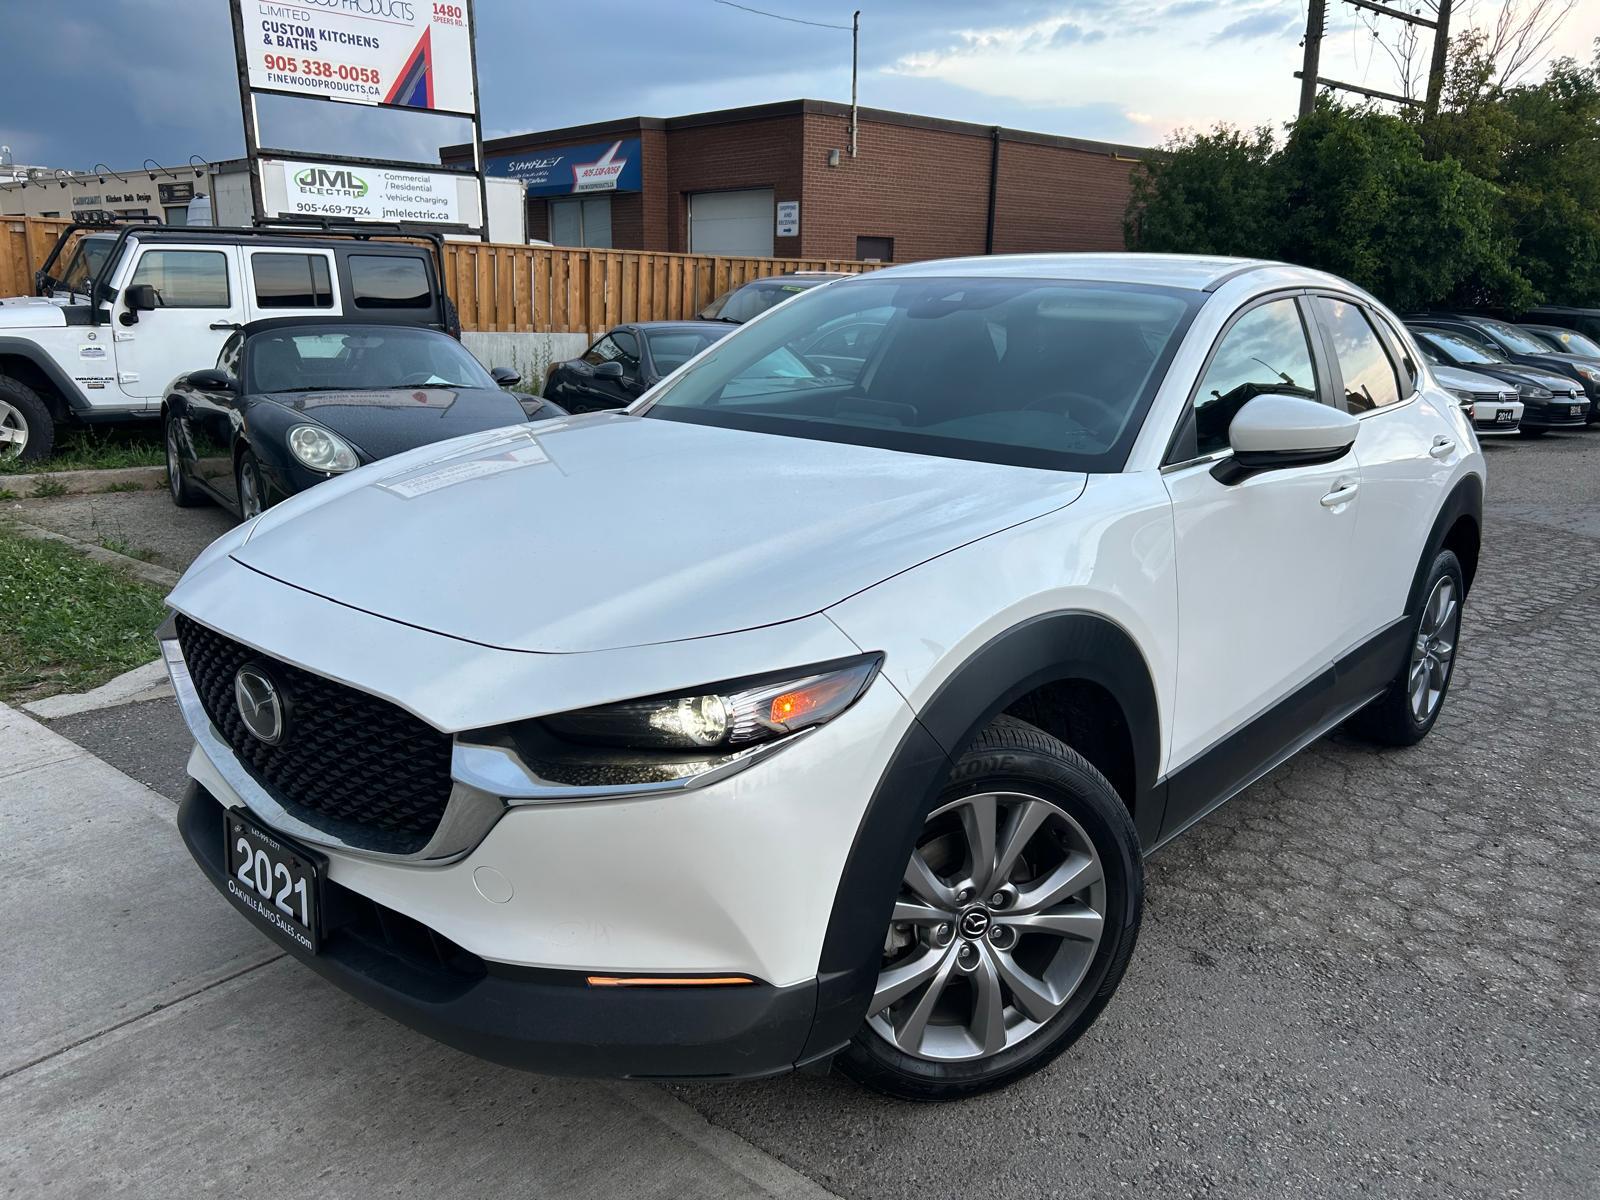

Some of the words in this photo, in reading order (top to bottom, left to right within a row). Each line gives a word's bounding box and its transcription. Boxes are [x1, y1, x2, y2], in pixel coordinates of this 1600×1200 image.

[259, 5, 311, 22] LIMITED
[432, 3, 462, 18] 1480
[432, 15, 453, 26] SPEERS
[261, 20, 315, 39] CUSTOM
[319, 29, 380, 49] KITCHENS
[263, 34, 273, 46] &
[276, 35, 318, 52] BATHS
[264, 54, 298, 73] 905
[302, 59, 380, 85] 338-0058
[267, 73, 381, 96] FINEWOODPRODUCTS.CA
[299, 168, 364, 190] JML
[384, 172, 431, 183] Commercial
[300, 186, 365, 198] ELECTRIC
[390, 182, 432, 192] Residential
[386, 193, 413, 203] Vehicle
[414, 194, 448, 206] Charging
[296, 202, 371, 216] 905-469-7524
[382, 206, 449, 220] jmlelectric.ca
[1498, 412, 1512, 420] 2014
[236, 837, 309, 928] 2021
